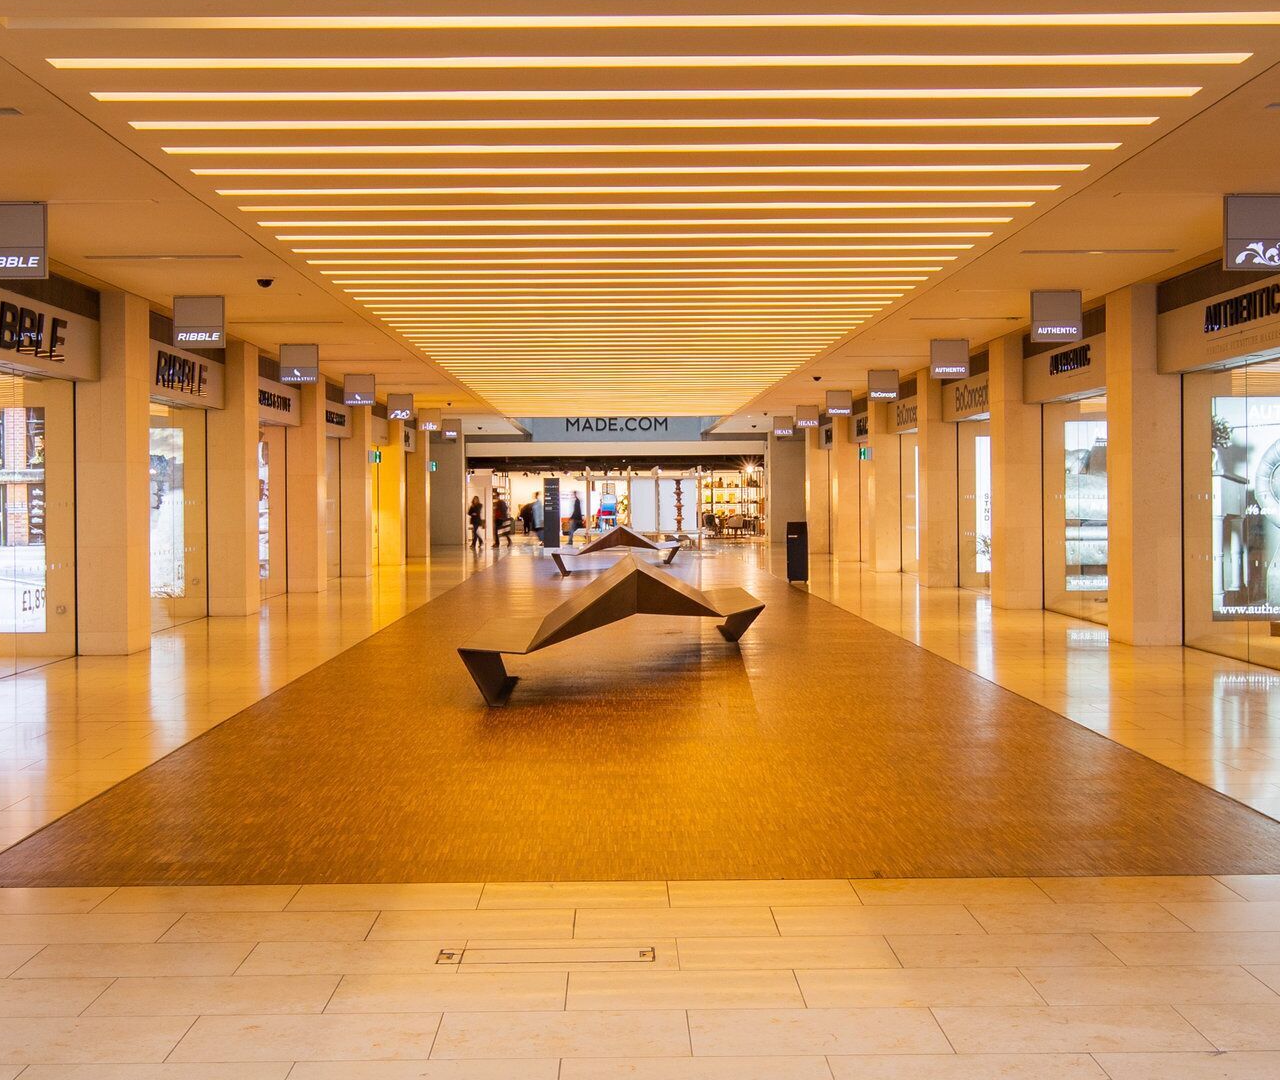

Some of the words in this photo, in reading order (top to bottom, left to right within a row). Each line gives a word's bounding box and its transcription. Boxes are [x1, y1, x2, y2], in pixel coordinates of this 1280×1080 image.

[177, 333, 220, 341] RIBBLE
[156, 350, 208, 397] RIBBLE
[1049, 344, 1091, 376] AUTHENTIC
[955, 380, 989, 412] BoConcept
[566, 417, 668, 432] MADE.COM
